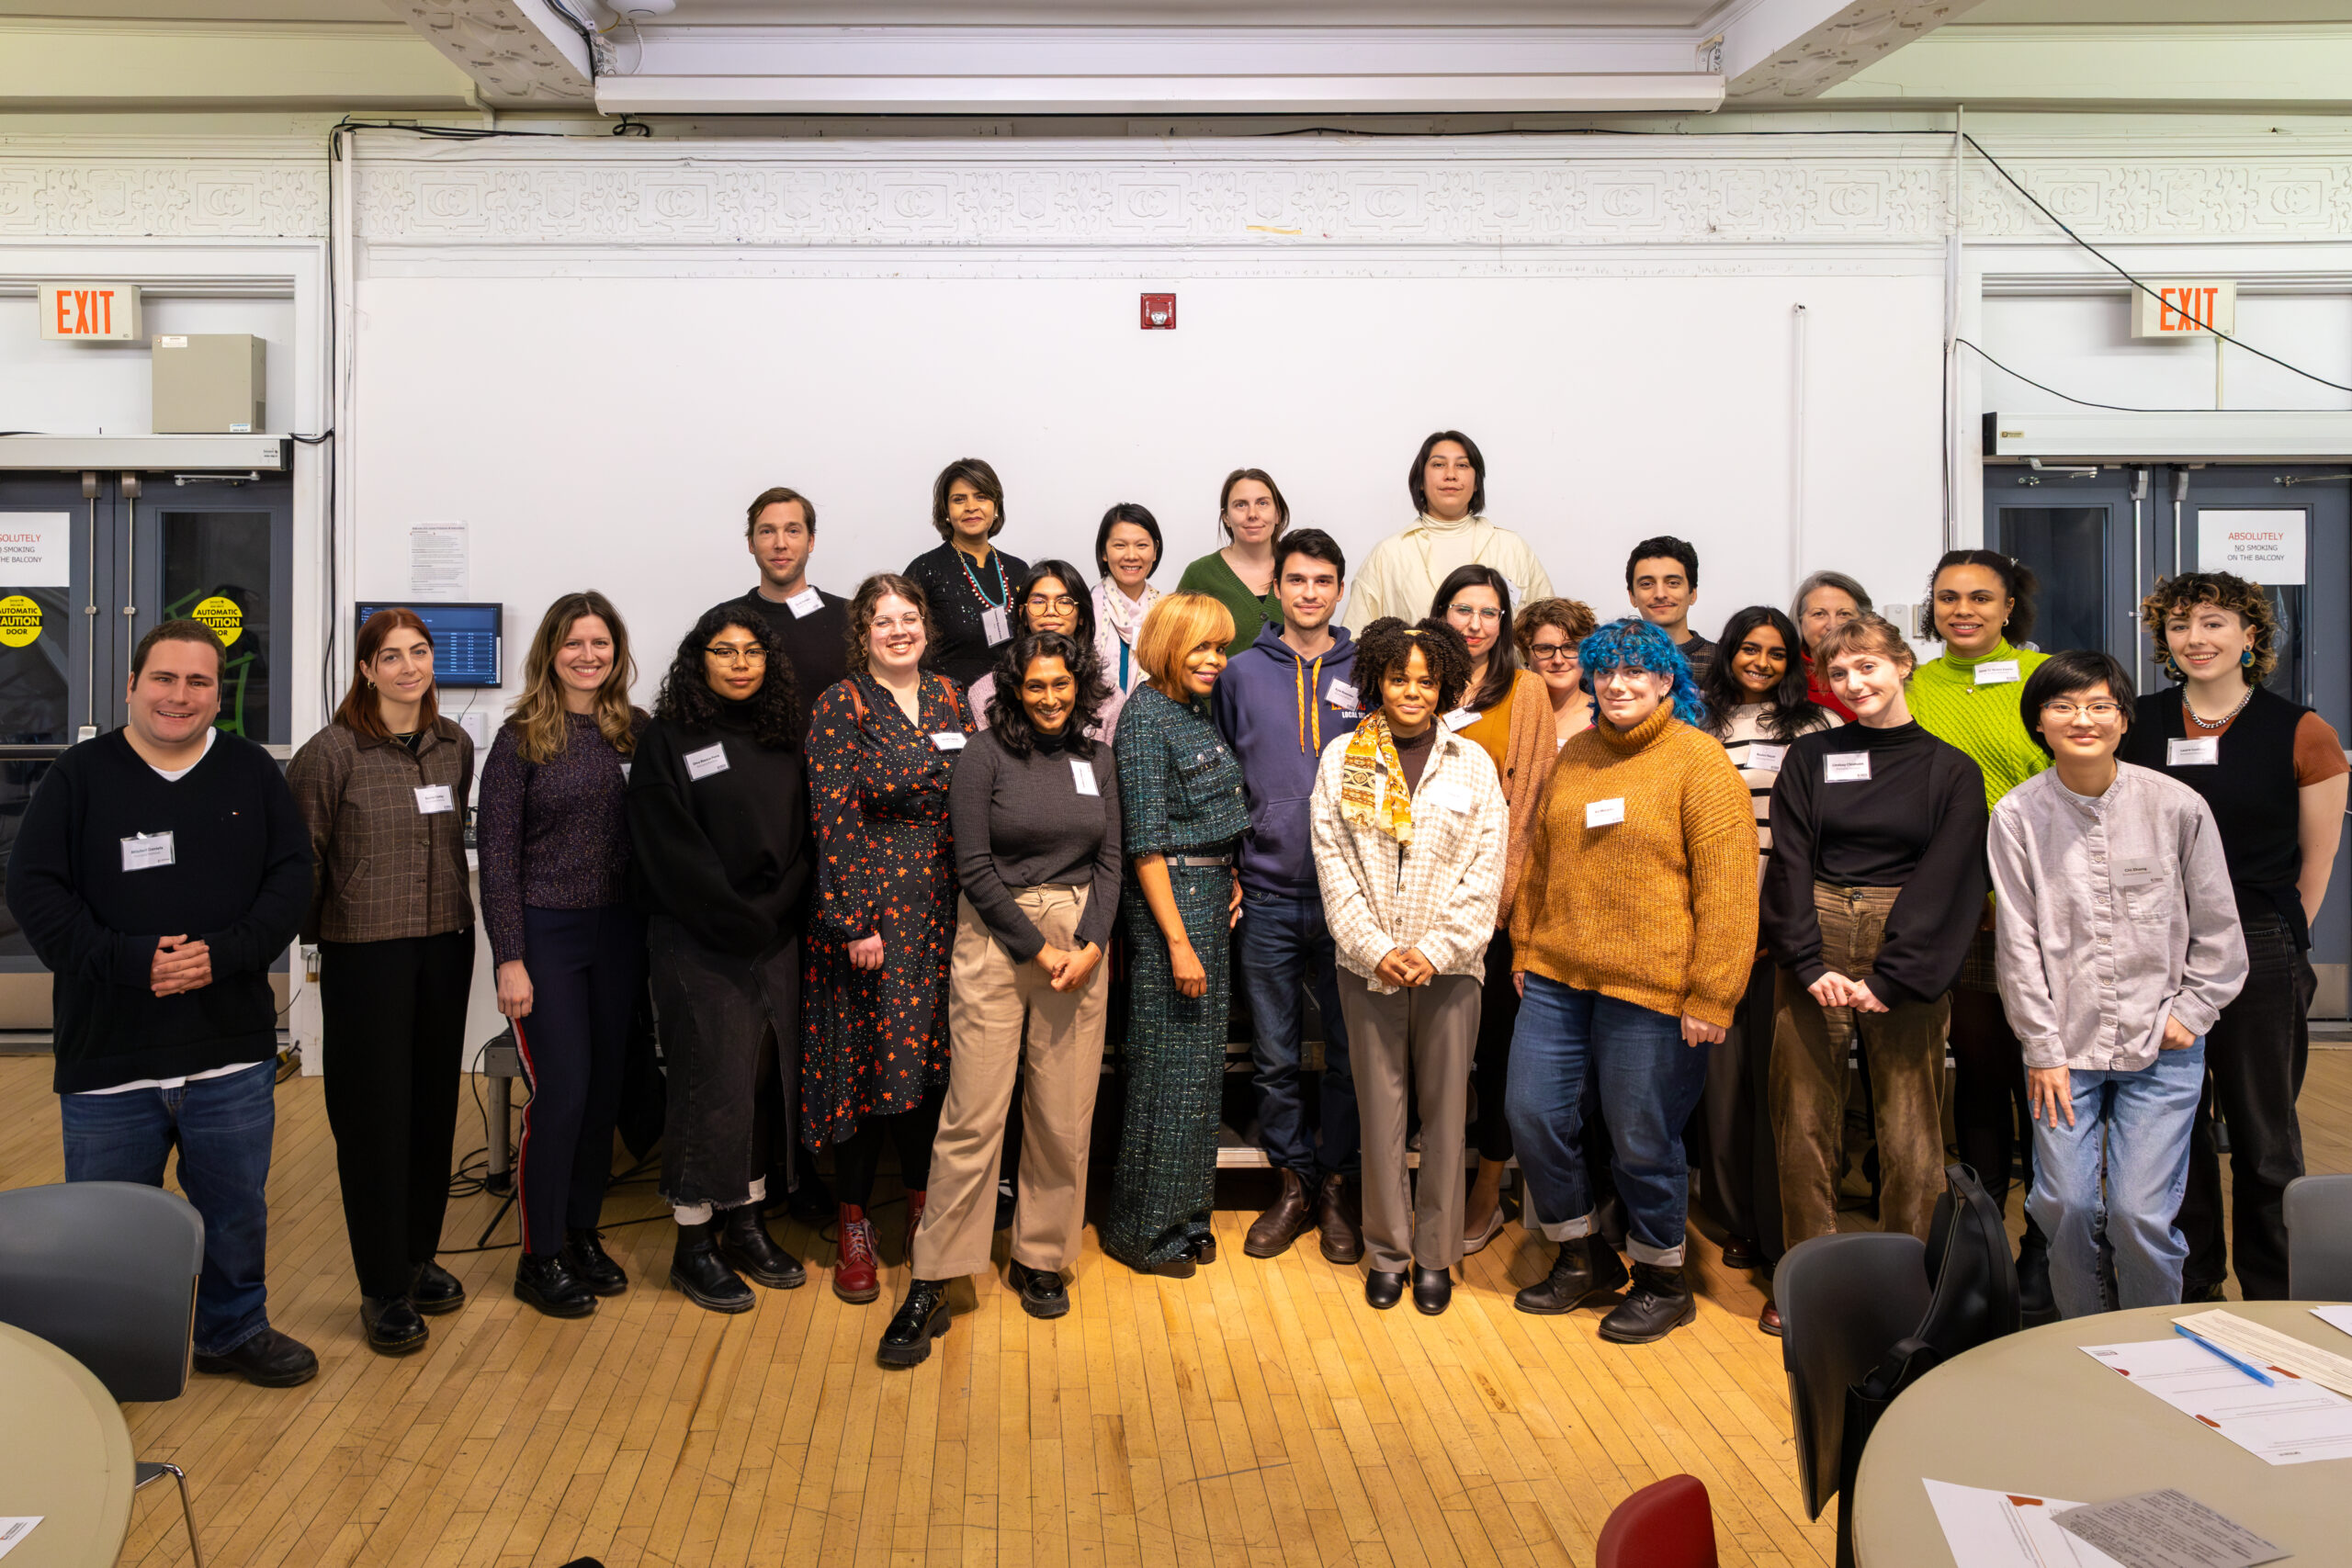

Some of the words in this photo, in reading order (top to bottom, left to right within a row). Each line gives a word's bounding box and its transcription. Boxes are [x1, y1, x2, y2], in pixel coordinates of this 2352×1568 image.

[57, 290, 114, 334] EXIT
[2160, 288, 2218, 331] EXIT
[2228, 532, 2284, 541] ABSOLUTELY
[0, 616, 40, 626] AUTION
